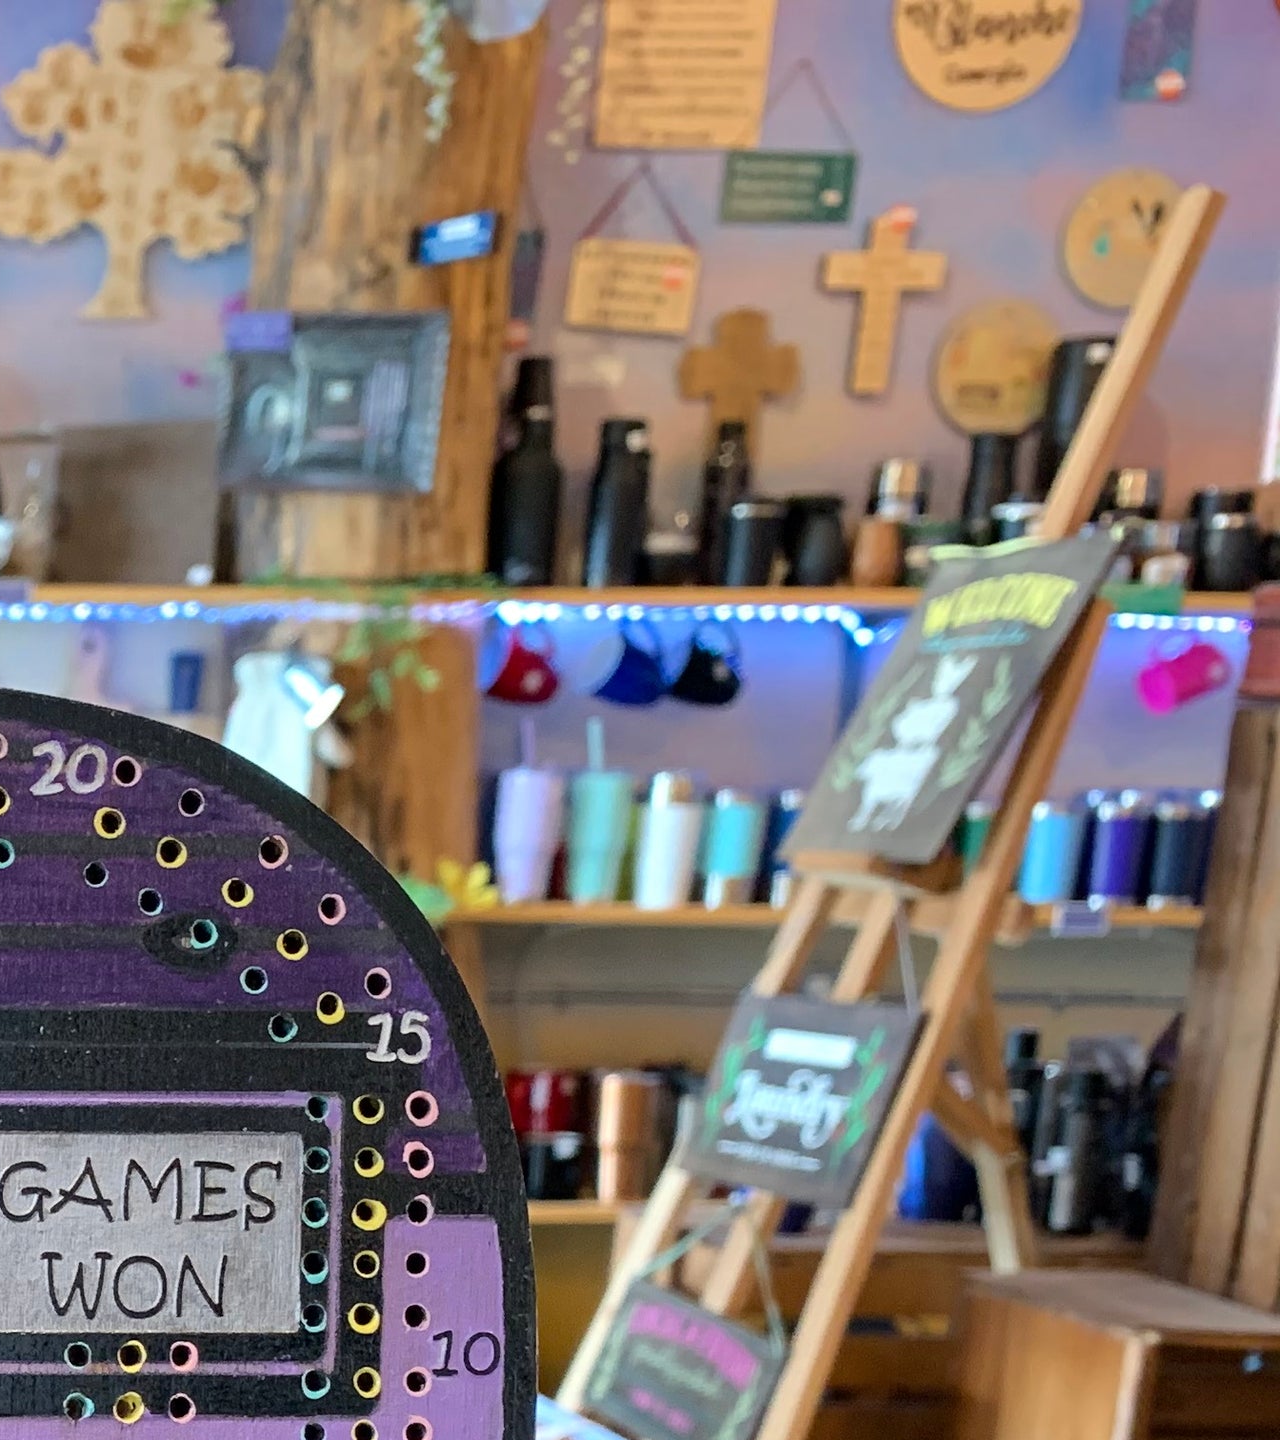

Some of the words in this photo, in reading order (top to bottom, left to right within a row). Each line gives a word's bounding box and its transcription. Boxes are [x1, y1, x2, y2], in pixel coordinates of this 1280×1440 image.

[30, 740, 108, 796] 20
[365, 1010, 432, 1064] 15
[40, 1251, 229, 1320] WON
[430, 1330, 501, 1378] 10
